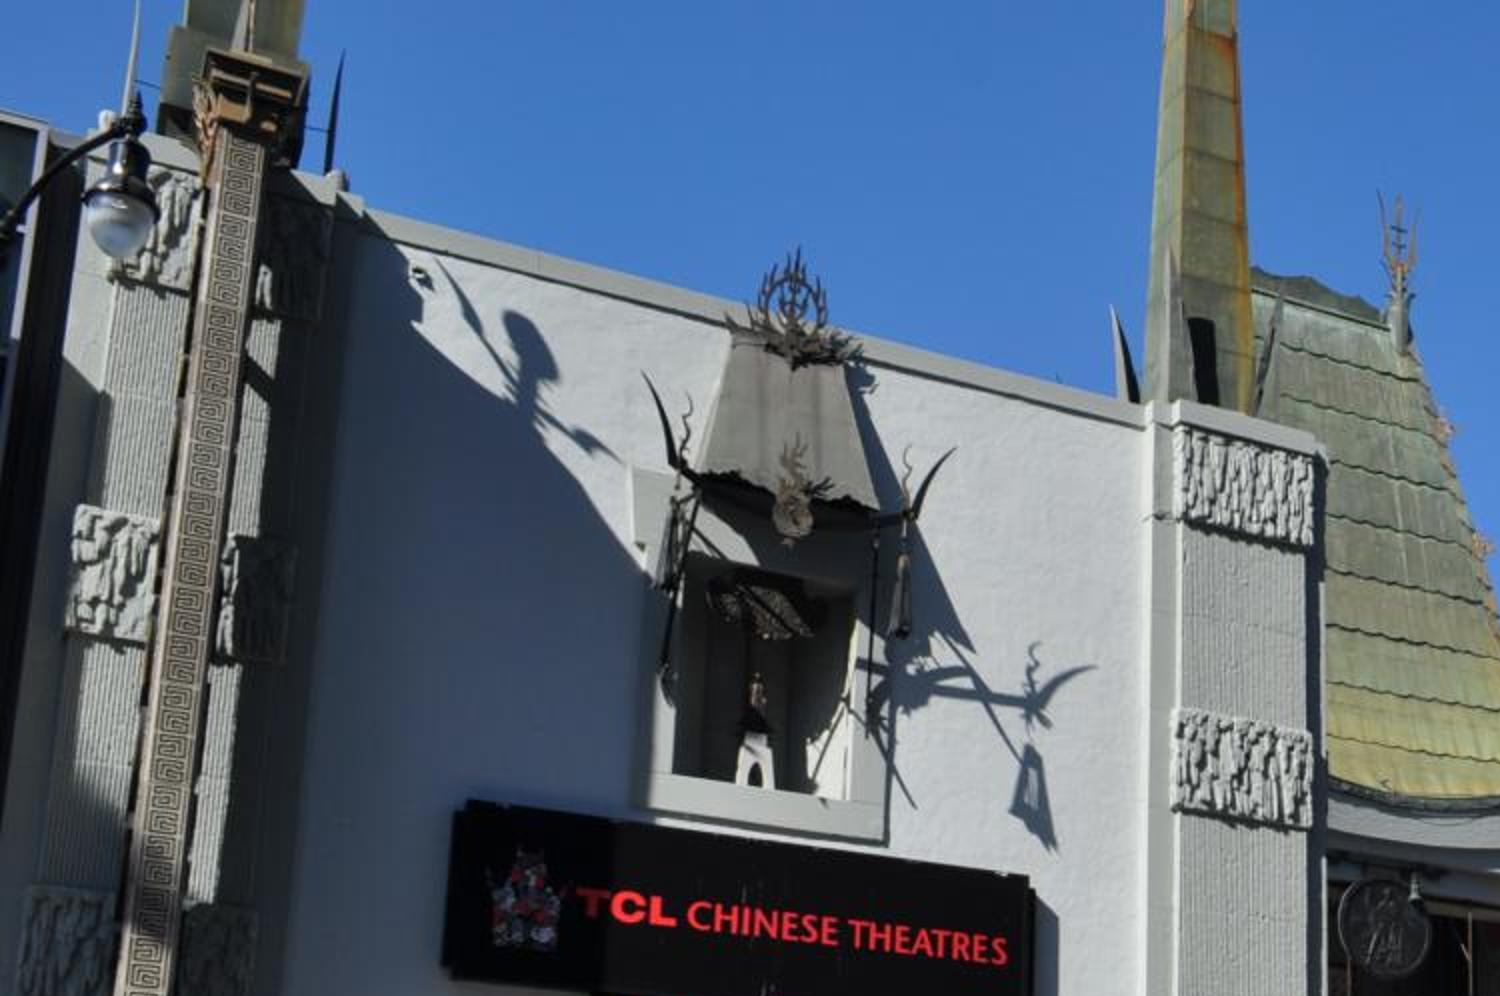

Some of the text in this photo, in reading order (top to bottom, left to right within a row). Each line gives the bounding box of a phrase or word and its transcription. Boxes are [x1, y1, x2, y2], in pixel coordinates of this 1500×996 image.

[575, 884, 1009, 966] TCL CHINESE THEATRES
